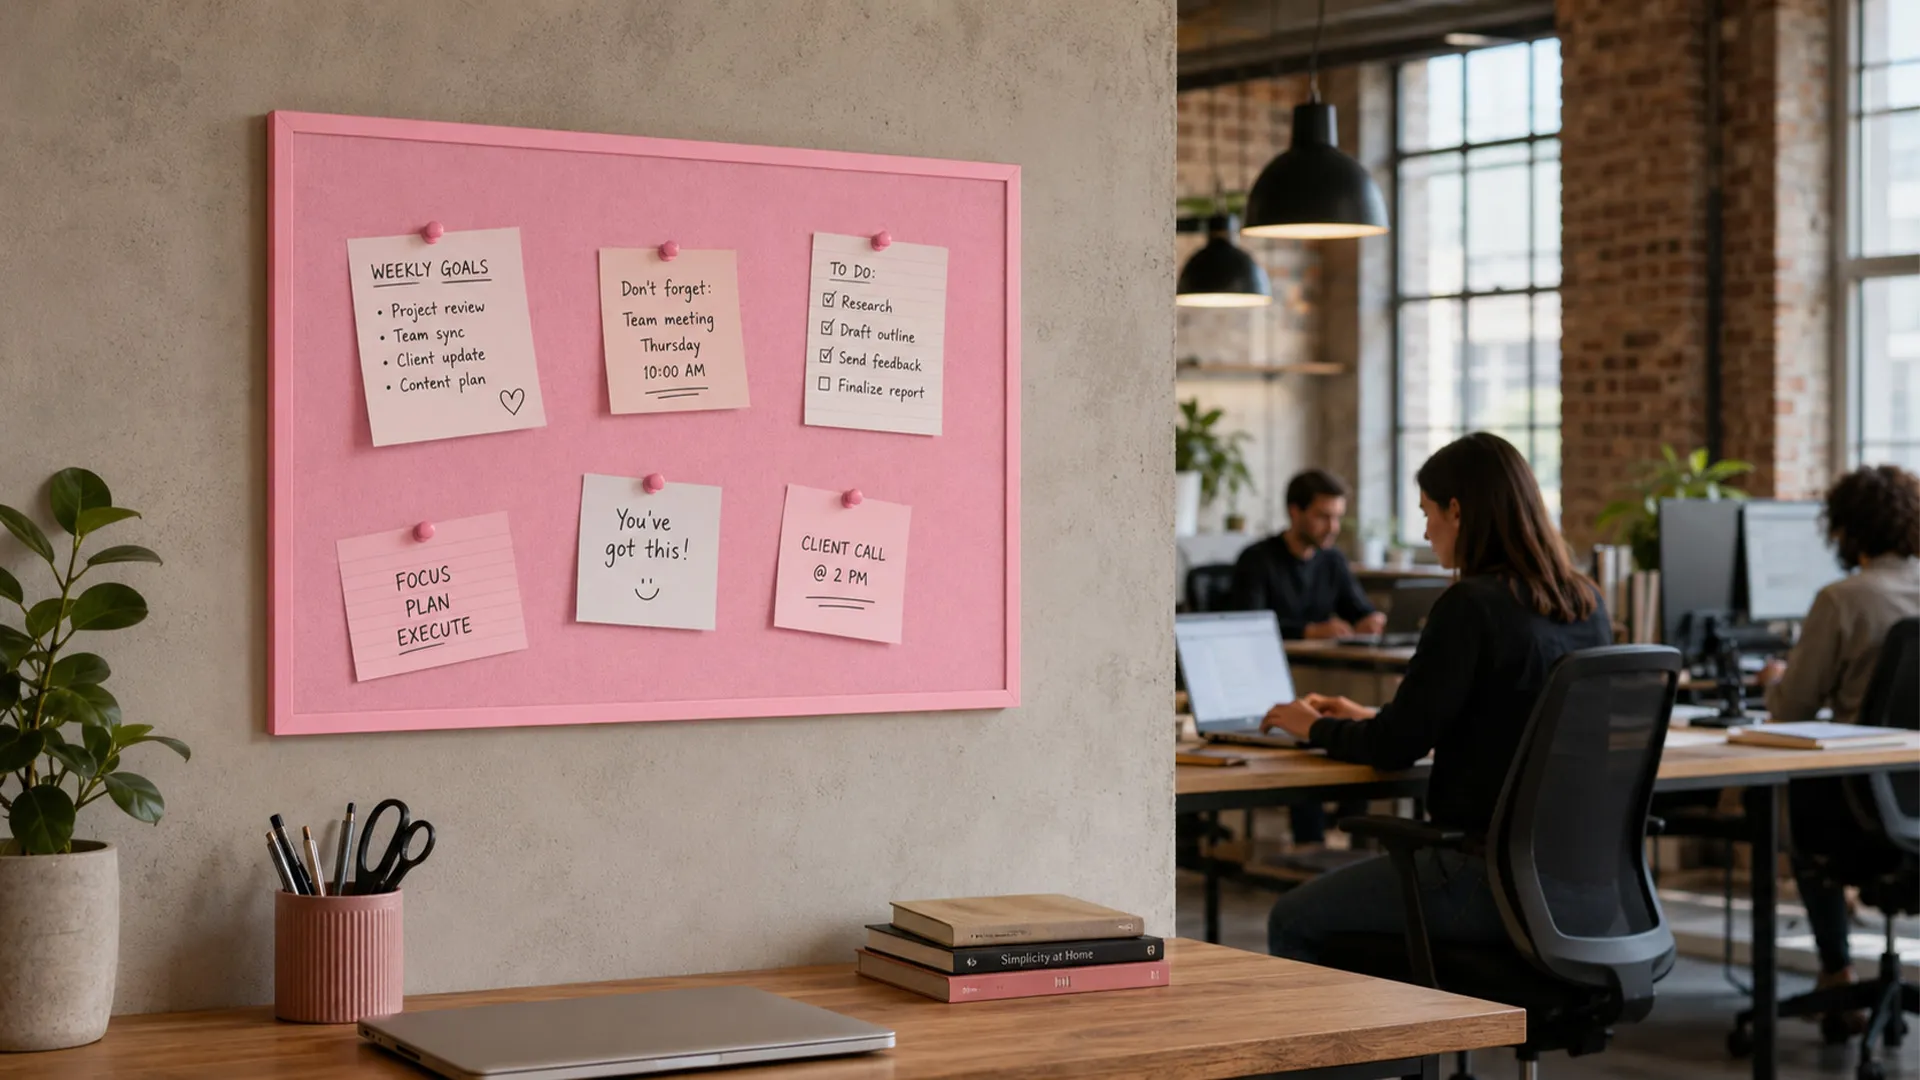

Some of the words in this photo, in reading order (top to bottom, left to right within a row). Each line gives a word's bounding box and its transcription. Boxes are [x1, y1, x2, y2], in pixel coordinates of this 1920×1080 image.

[370, 261, 432, 280] WEEKLY
[441, 259, 489, 277] GOALS
[830, 261, 847, 276] TO
[854, 264, 876, 279] DO:
[621, 280, 656, 296] Don't
[664, 278, 712, 303] forget:
[391, 302, 438, 323] Project
[445, 301, 485, 314] review
[841, 294, 893, 313] Research
[622, 311, 657, 327] Team
[664, 311, 714, 333] meeting
[840, 323, 872, 339] Draft
[877, 328, 915, 343] outline
[393, 328, 429, 343] Team
[436, 327, 465, 346] sync
[640, 336, 701, 358] Thursday
[397, 351, 435, 368] Client
[442, 348, 486, 368] update
[839, 351, 867, 366] Send
[872, 353, 922, 372] feedback
[400, 375, 451, 393] Content
[459, 372, 486, 393] plan
[644, 365, 679, 380] 10:00
[685, 363, 706, 377] AM
[838, 378, 883, 396] Finalize
[889, 385, 925, 402] report
[616, 508, 671, 531] You've
[605, 538, 636, 568] got
[645, 538, 689, 561] this!
[801, 535, 850, 555] CLIENT
[854, 543, 886, 561] CALL
[395, 565, 451, 591] FOCUS
[813, 564, 827, 582] @
[833, 568, 842, 582] 2
[848, 569, 868, 586] PM
[405, 593, 450, 618] PLAN
[397, 616, 472, 646] EXECUTE
[1000, 952, 1050, 967] Simplicity
[1052, 952, 1063, 961] at
[1065, 950, 1093, 960] Home
